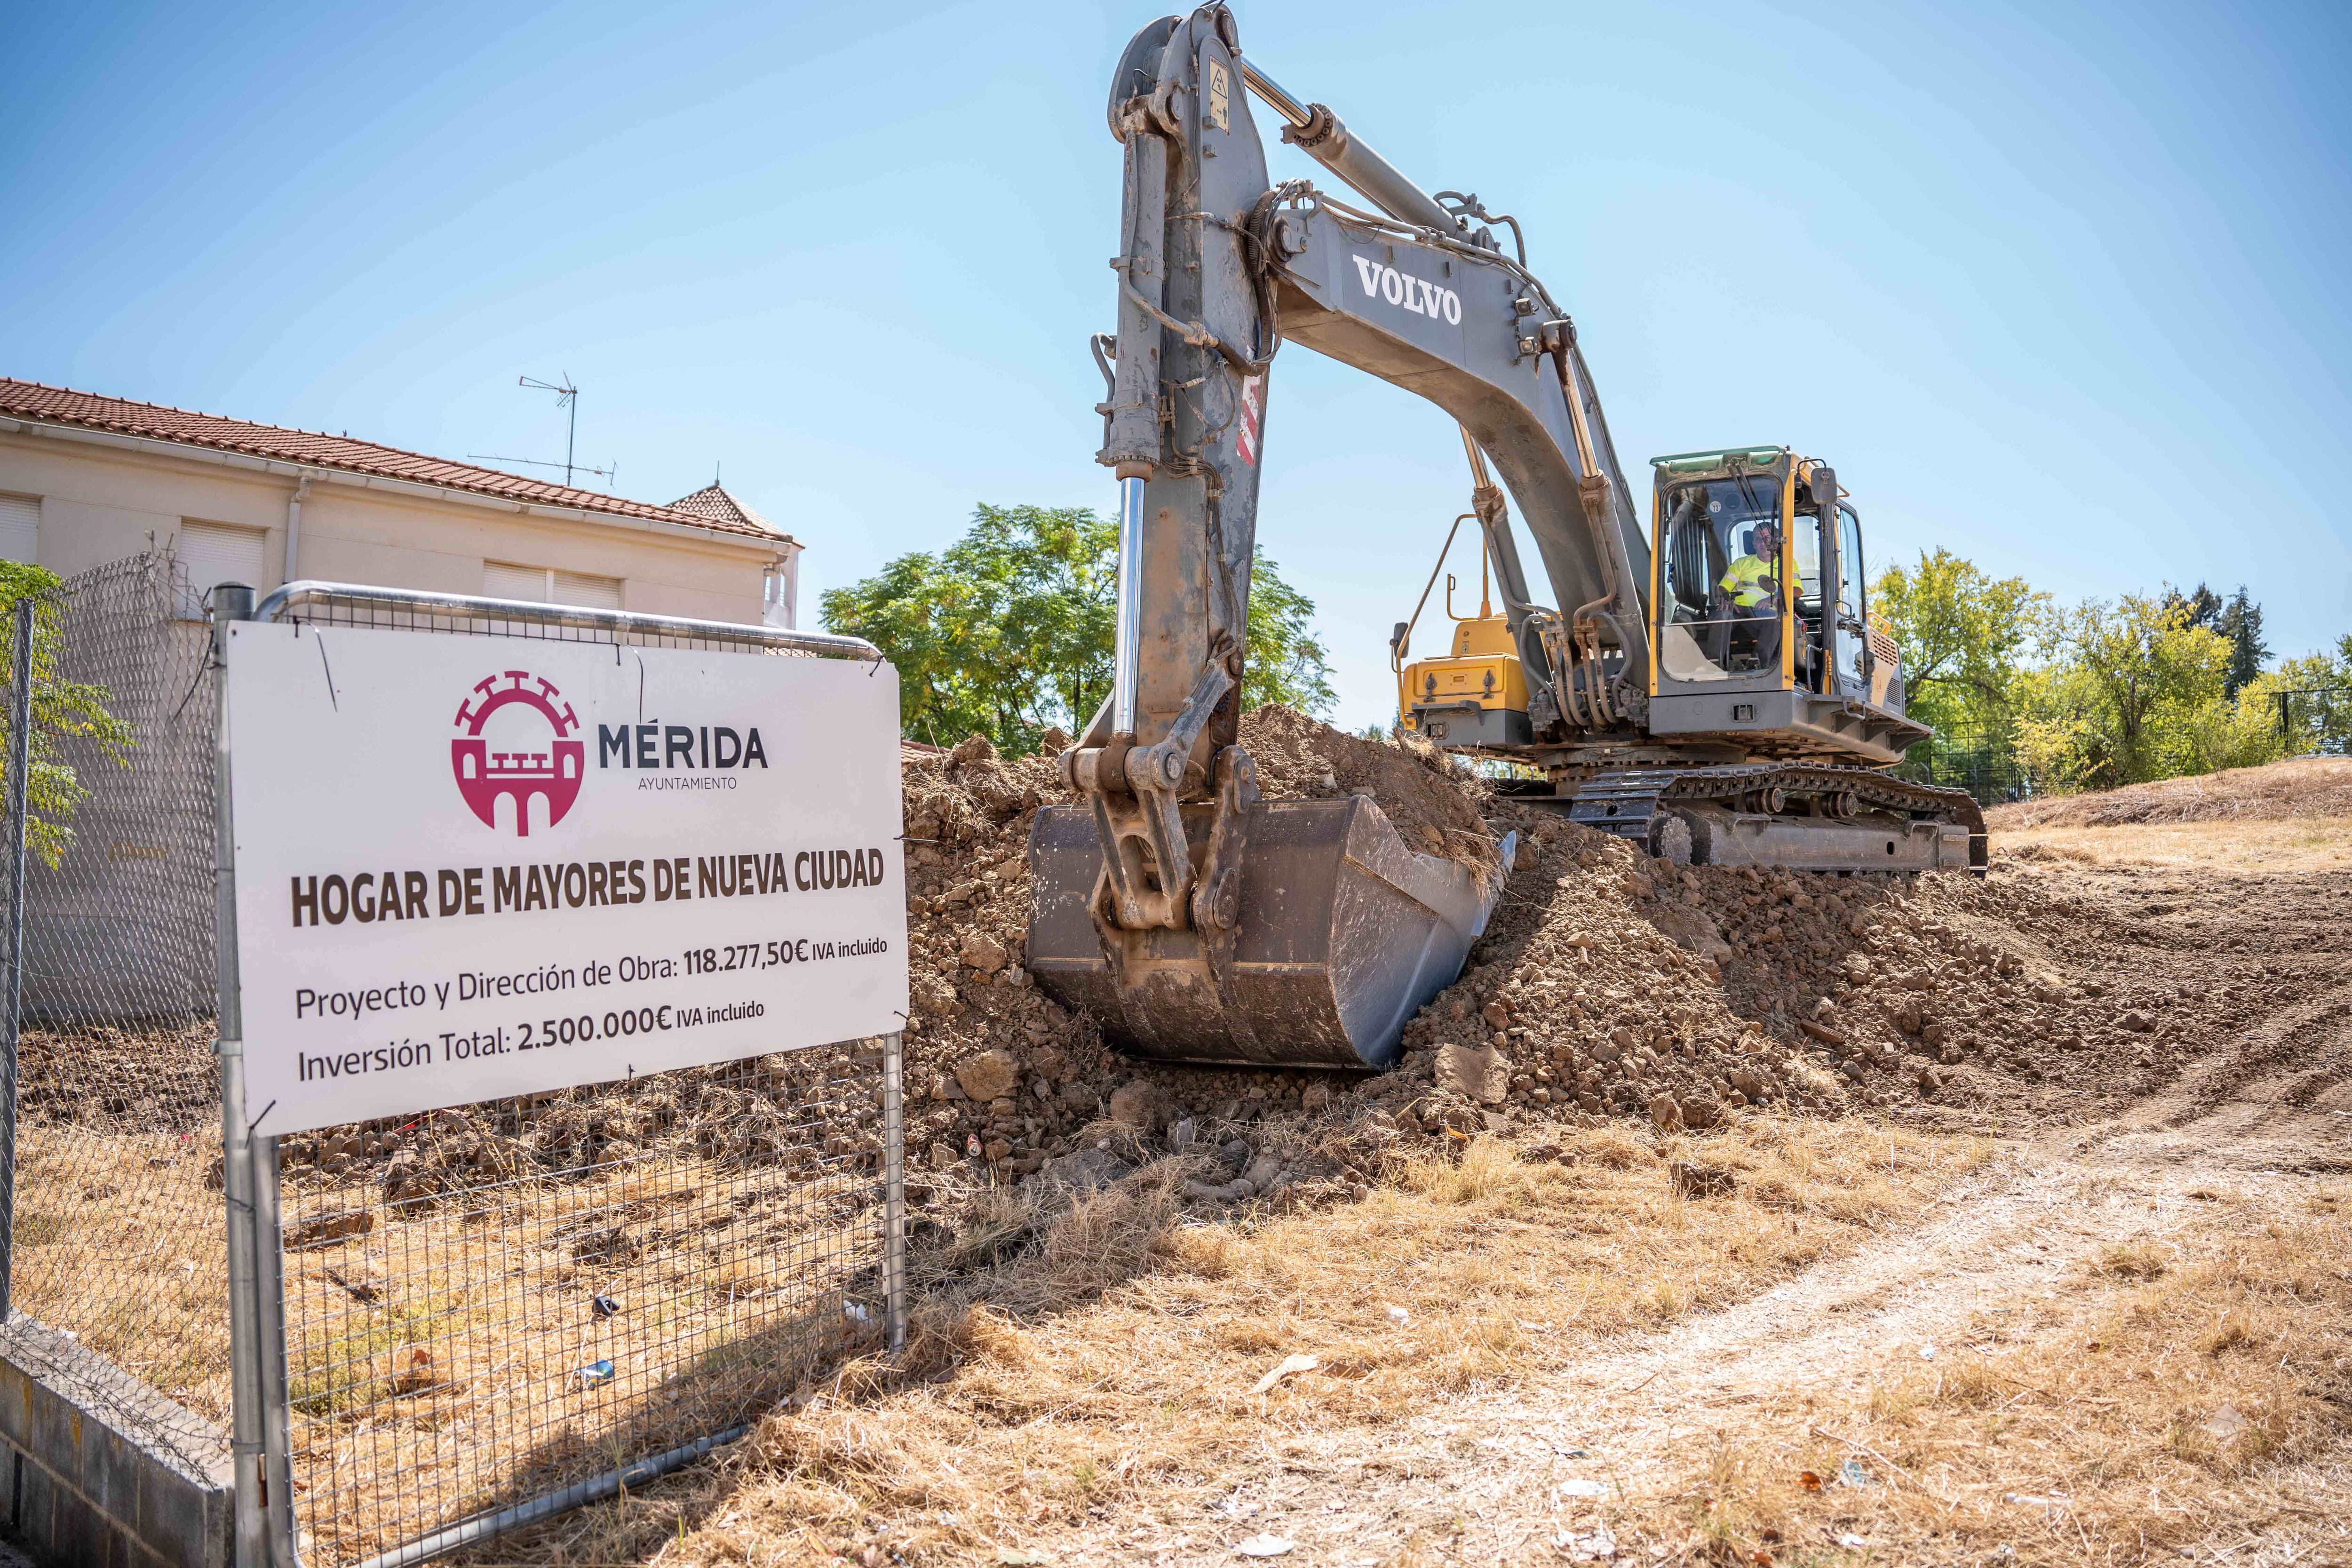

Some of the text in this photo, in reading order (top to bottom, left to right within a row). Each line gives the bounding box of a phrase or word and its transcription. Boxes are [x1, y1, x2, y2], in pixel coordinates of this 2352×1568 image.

[1353, 254, 1462, 325] VOLVO
[598, 718, 768, 768] MÉRIDA
[638, 777, 737, 790] AYUNTAMIENTO
[291, 848, 884, 927] HOGAR DE MAYORES DE NUEVA CIUDAD
[296, 937, 887, 1020] Proyecto y Dirección de Obra: 118.277,50€ IVA incluido
[299, 1000, 764, 1082] Inversión Total: 2.500.000€ IVA incluido
